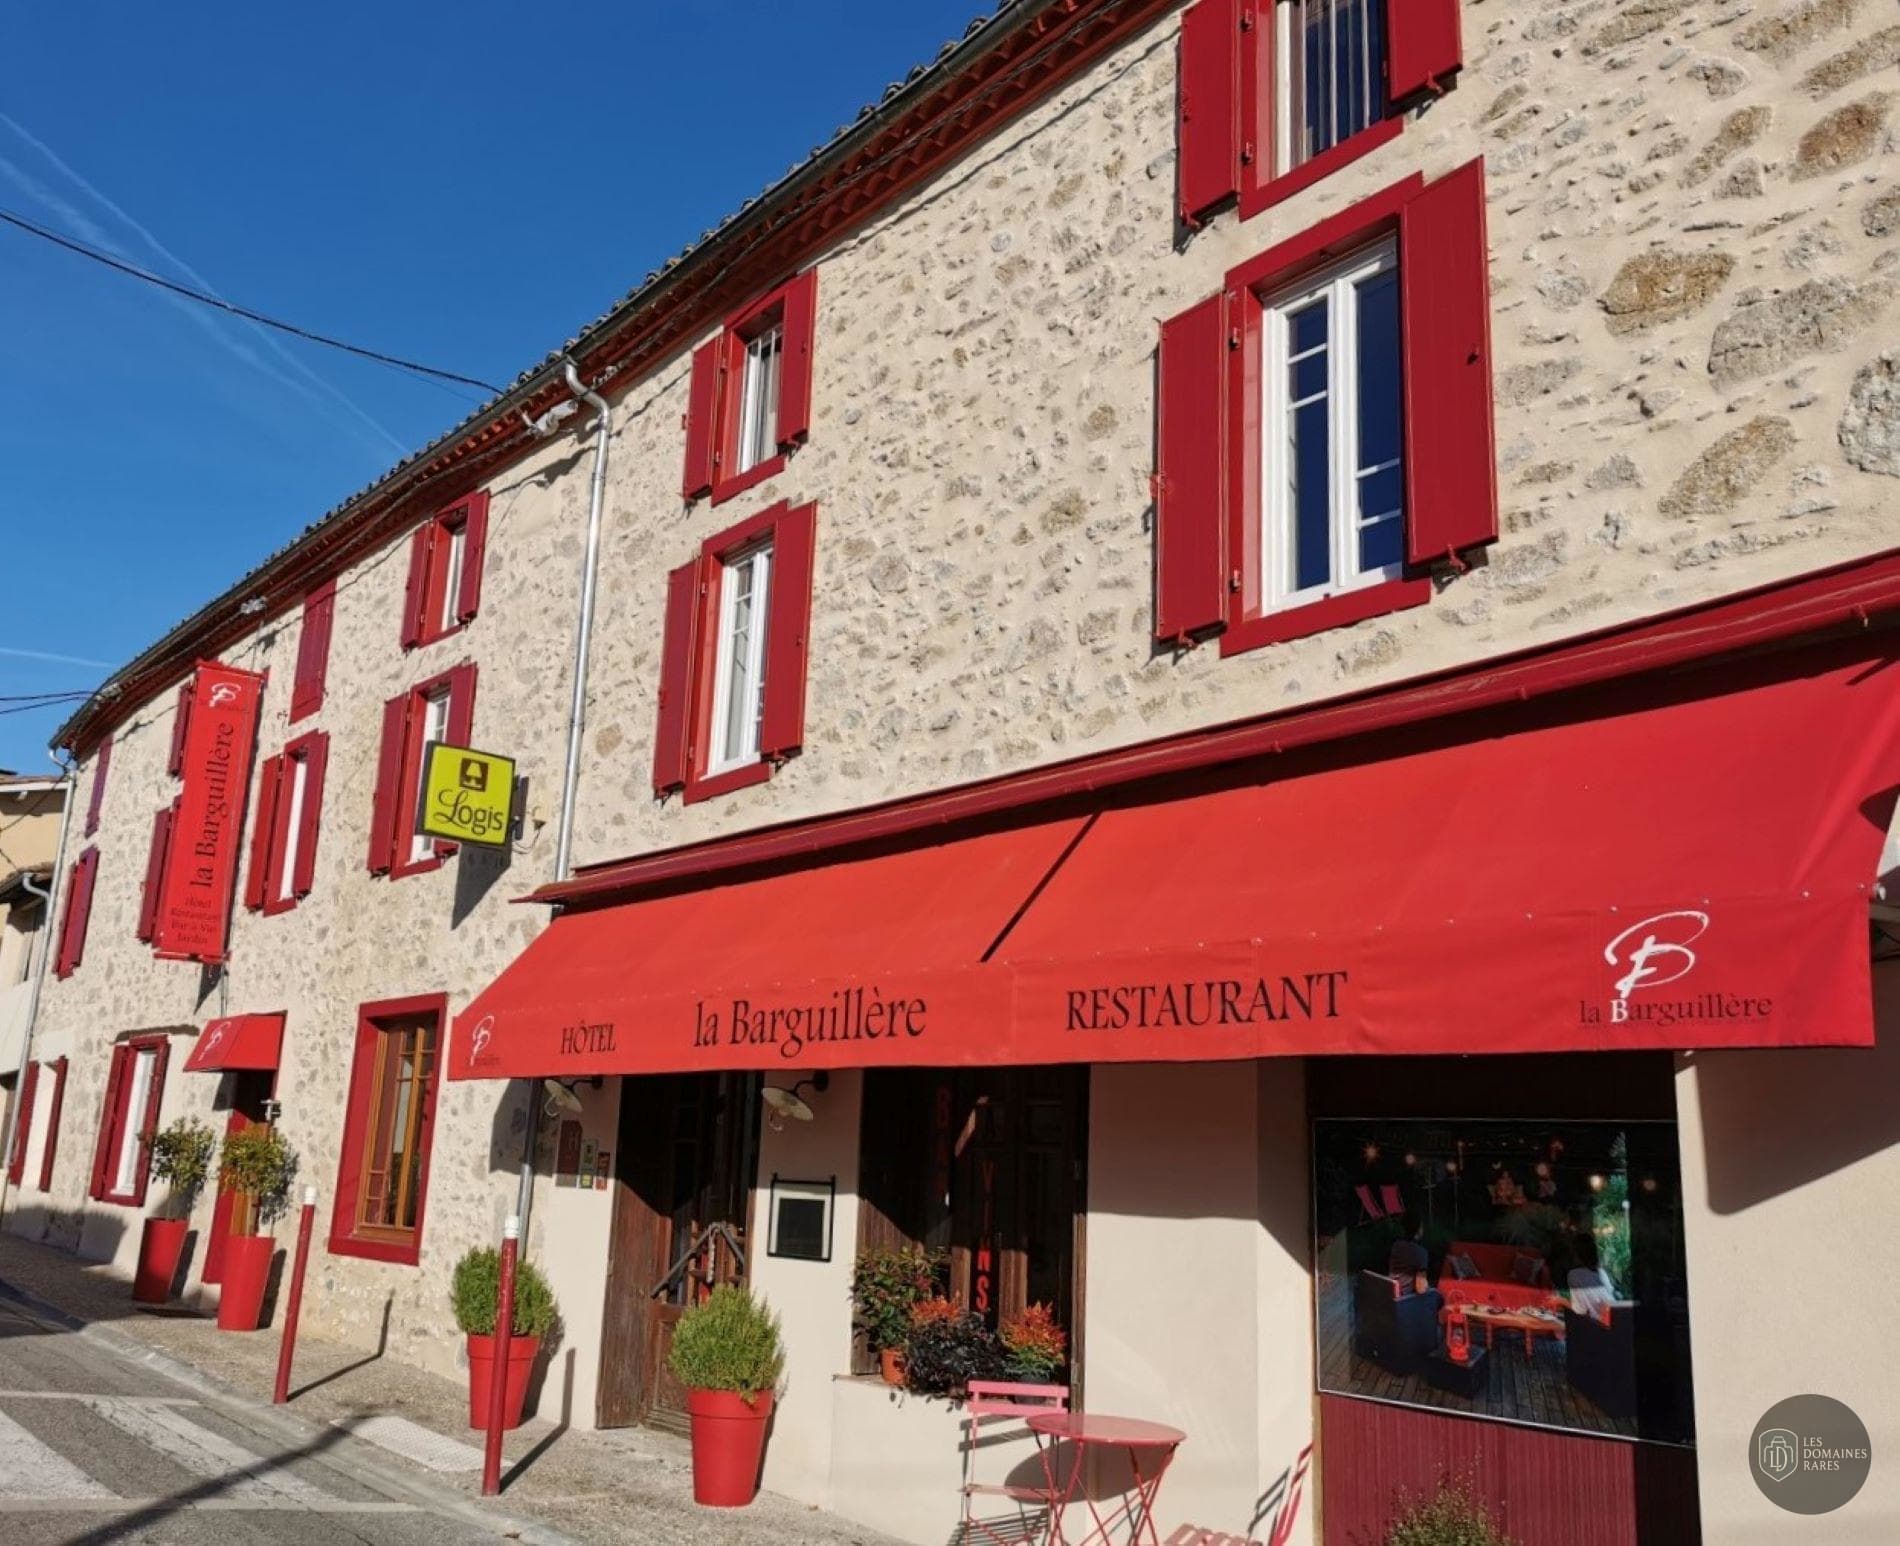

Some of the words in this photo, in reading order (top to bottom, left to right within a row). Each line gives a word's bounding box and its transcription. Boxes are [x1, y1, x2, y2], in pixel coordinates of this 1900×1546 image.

[194, 722, 234, 857] Barguillère
[433, 788, 504, 836] Logis
[190, 866, 214, 888] la
[693, 1000, 719, 1048] la
[729, 985, 927, 1059] Barguillère
[1065, 970, 1348, 1032] RESTAURANT
[1579, 1000, 1600, 1024] la
[1610, 993, 1773, 1026] Barguillère
[560, 1019, 617, 1056] HÔTEL
